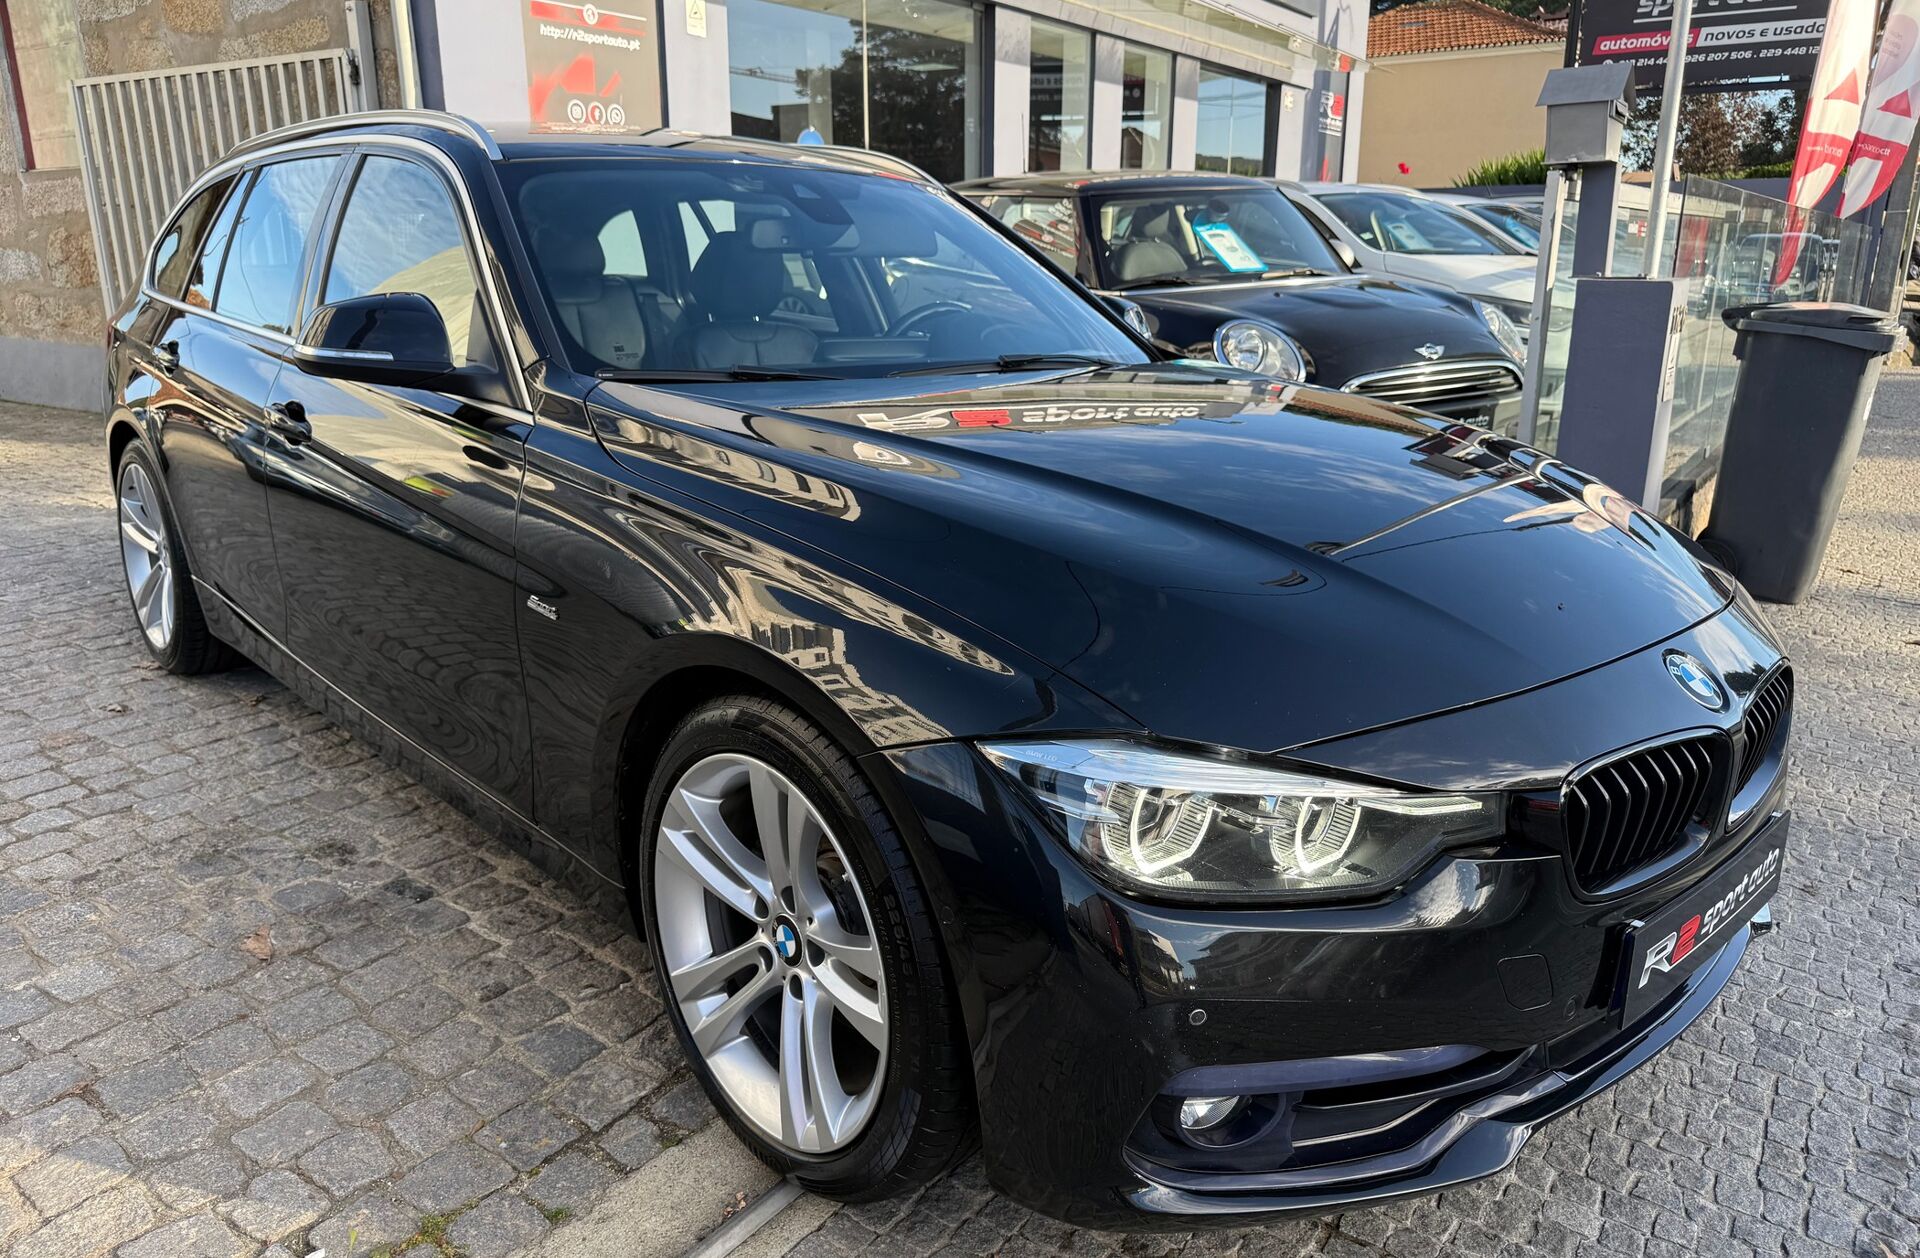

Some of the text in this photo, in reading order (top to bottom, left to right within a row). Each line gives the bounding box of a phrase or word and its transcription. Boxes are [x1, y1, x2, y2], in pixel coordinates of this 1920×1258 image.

[540, 24, 641, 51] http://r2sportauto.pt
[1599, 33, 1694, 51] automóvs
[1704, 29, 1756, 41] novos
[1773, 21, 1826, 36] usado
[1637, 57, 1656, 67] 214
[1684, 53, 1705, 63] 926
[1707, 52, 1729, 62] 207
[1730, 50, 1753, 60] 506
[1759, 48, 1782, 58] 229
[1784, 45, 1806, 56] 448
[1808, 45, 1820, 54] 12
[1637, 847, 1780, 989] R2 sport auto
